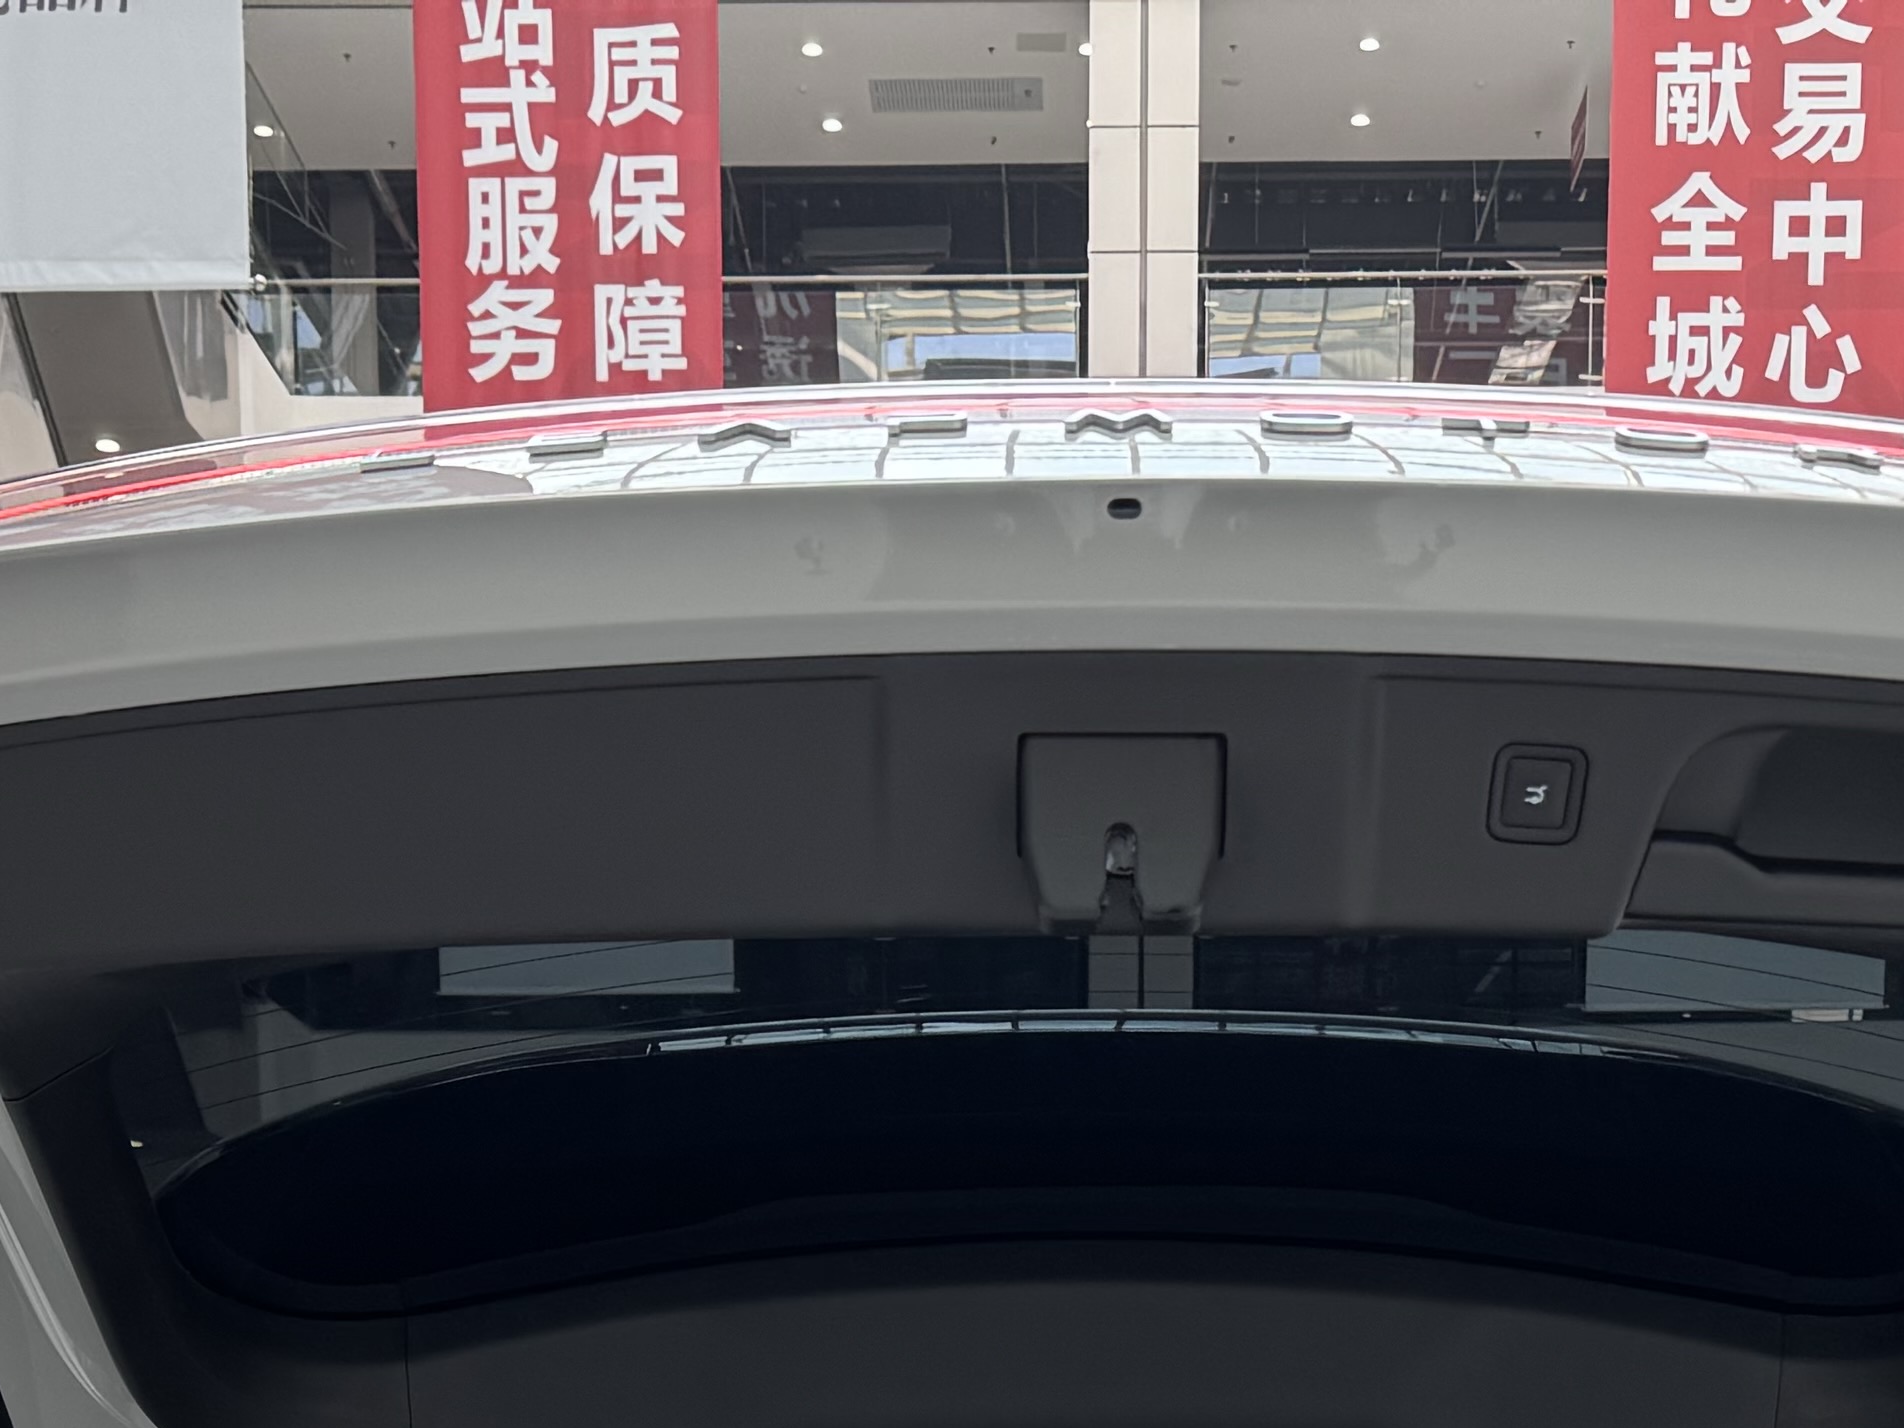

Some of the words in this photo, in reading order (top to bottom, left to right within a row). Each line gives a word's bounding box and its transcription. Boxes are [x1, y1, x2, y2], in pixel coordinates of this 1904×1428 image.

[587, 22, 688, 382] 质保障
[1647, 0, 1752, 397] 献全城
